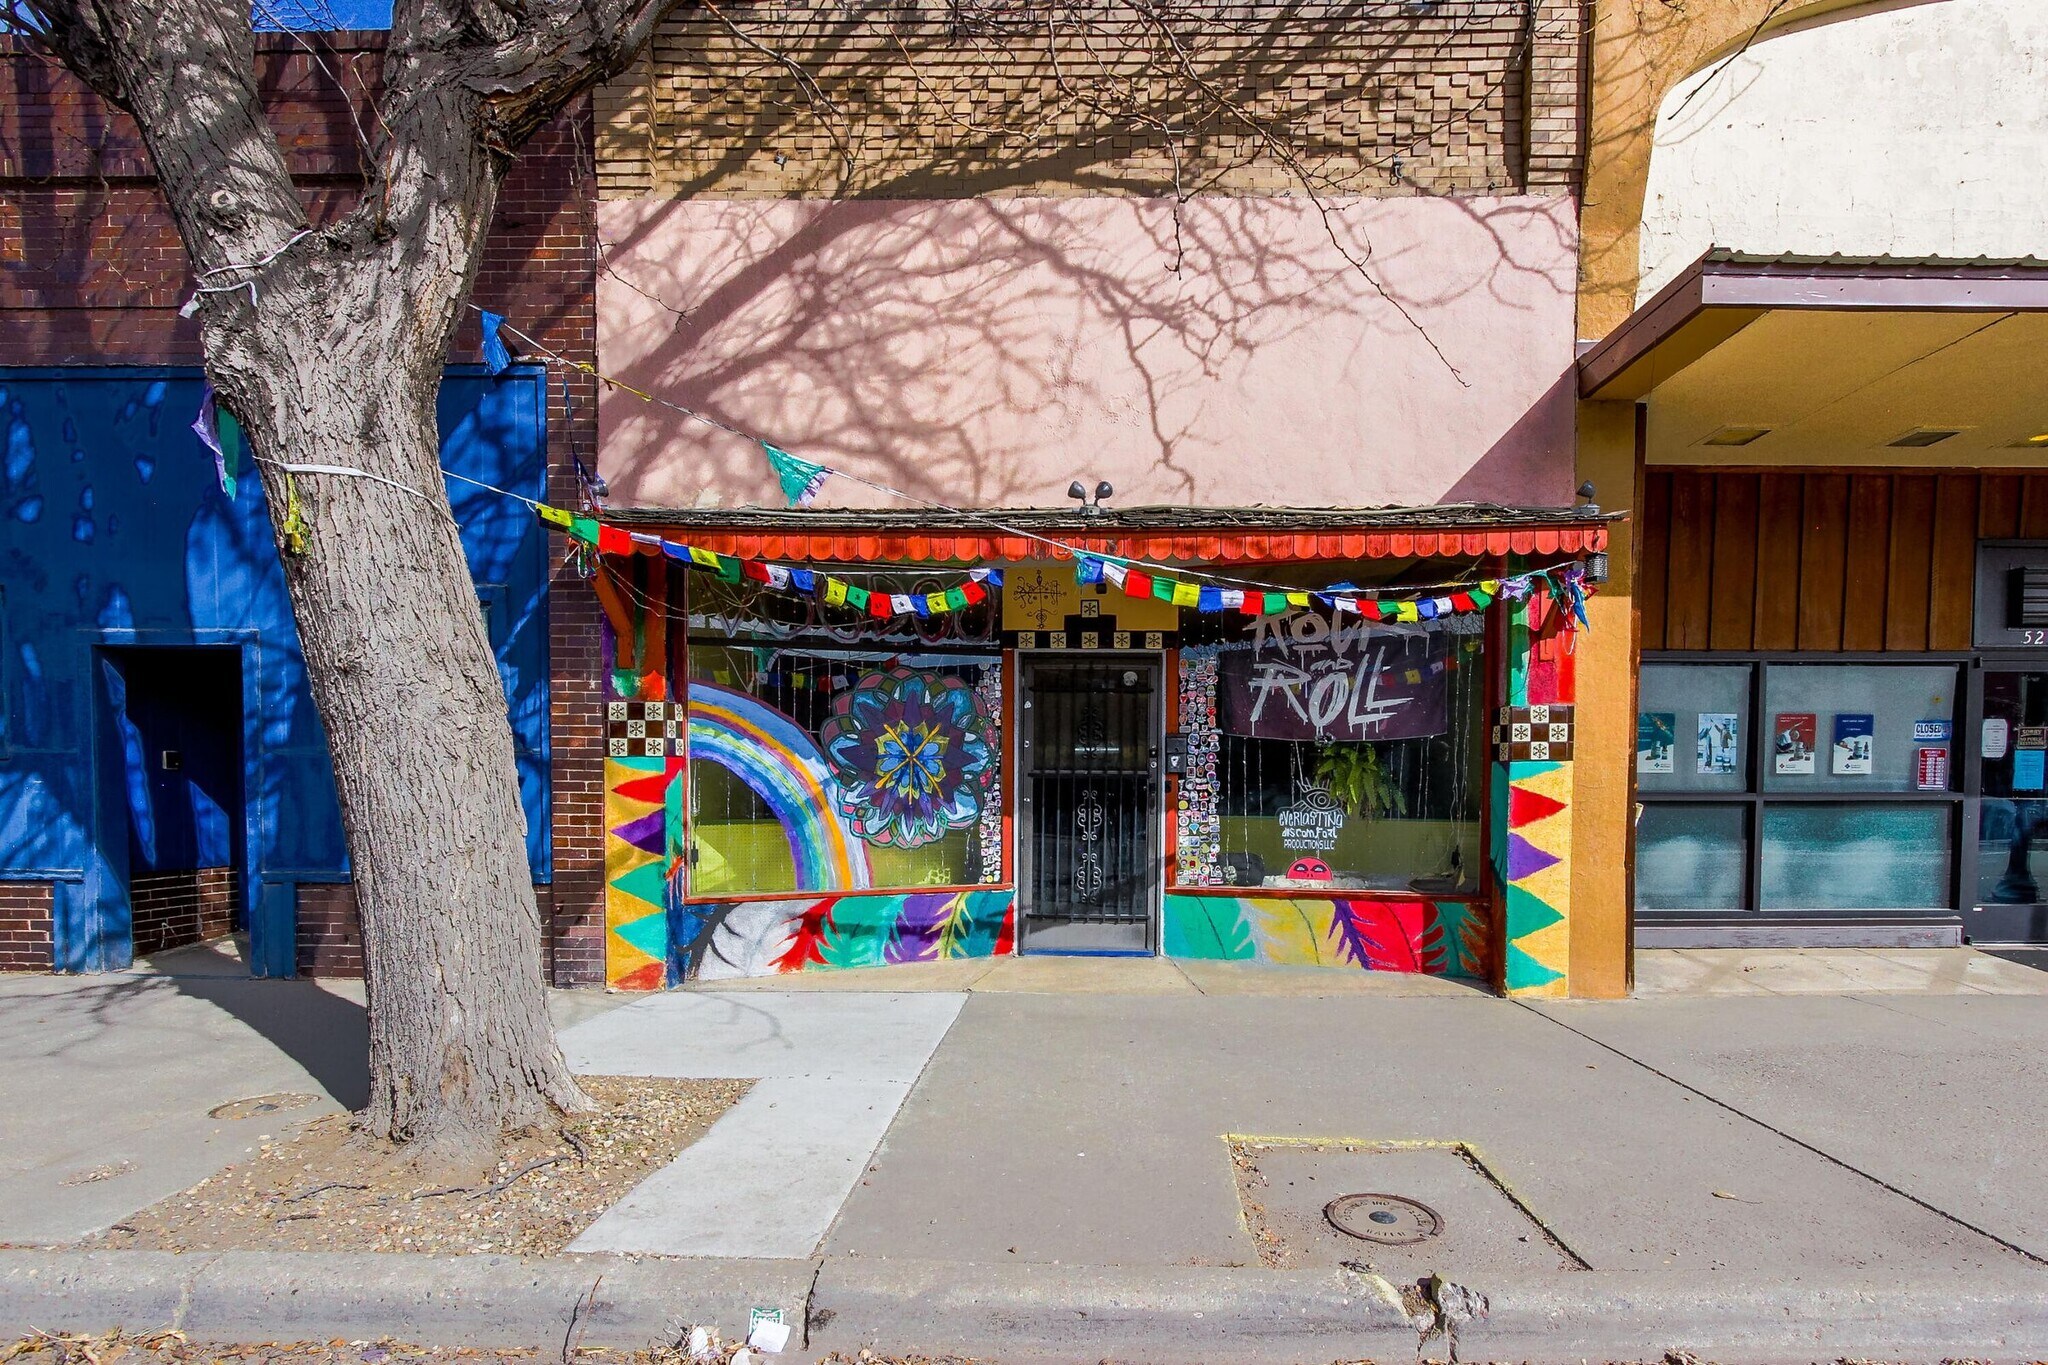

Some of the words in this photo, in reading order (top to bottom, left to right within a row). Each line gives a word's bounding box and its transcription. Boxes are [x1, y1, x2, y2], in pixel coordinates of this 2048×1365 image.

[2022, 630, 2045, 645] 52
[1249, 646, 1414, 734] ROLL
[1916, 724, 1942, 734] CLOSED
